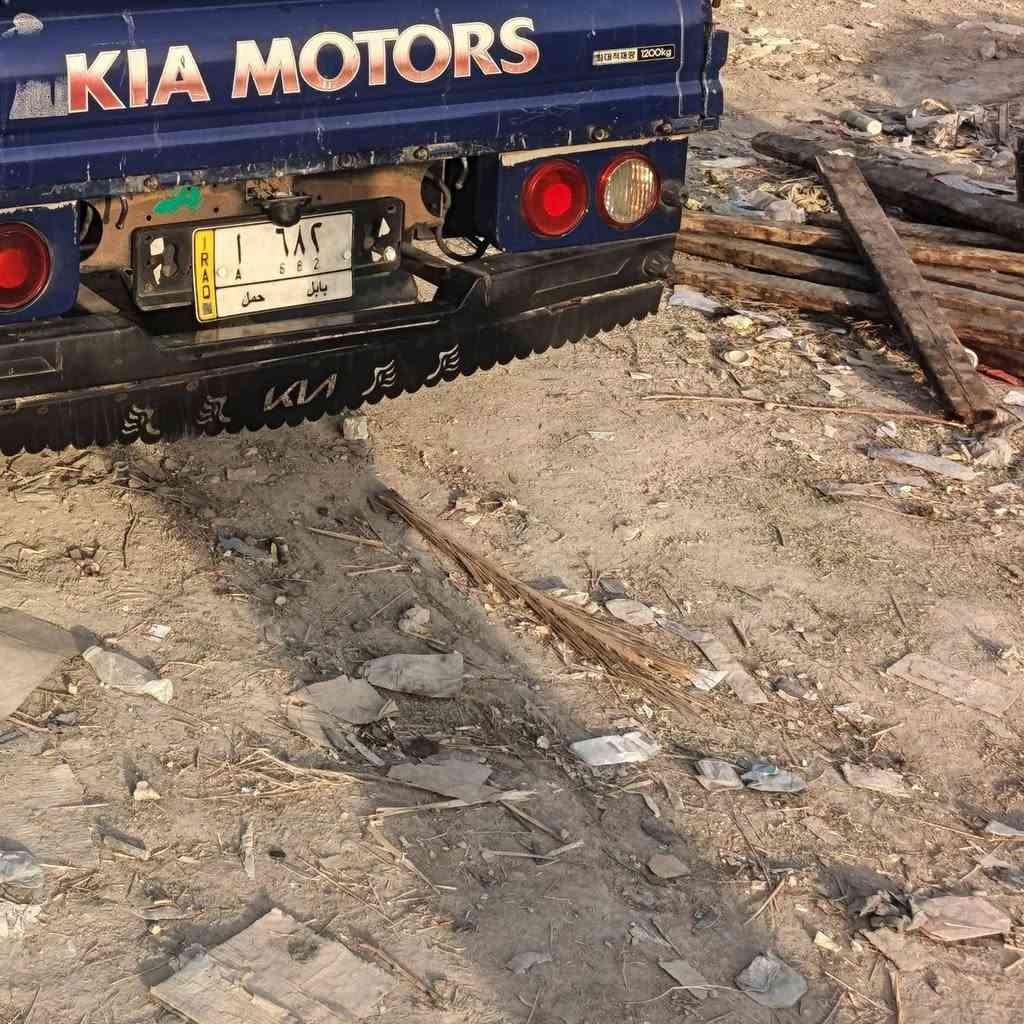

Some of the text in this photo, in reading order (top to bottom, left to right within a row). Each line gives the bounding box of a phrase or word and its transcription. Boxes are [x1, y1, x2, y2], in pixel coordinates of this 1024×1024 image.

[640, 47, 672, 59] 1200kg
[65, 16, 540, 114] KIA MOTORS
[234, 268, 242, 281] A
[241, 279, 328, 307] بابل حمل
